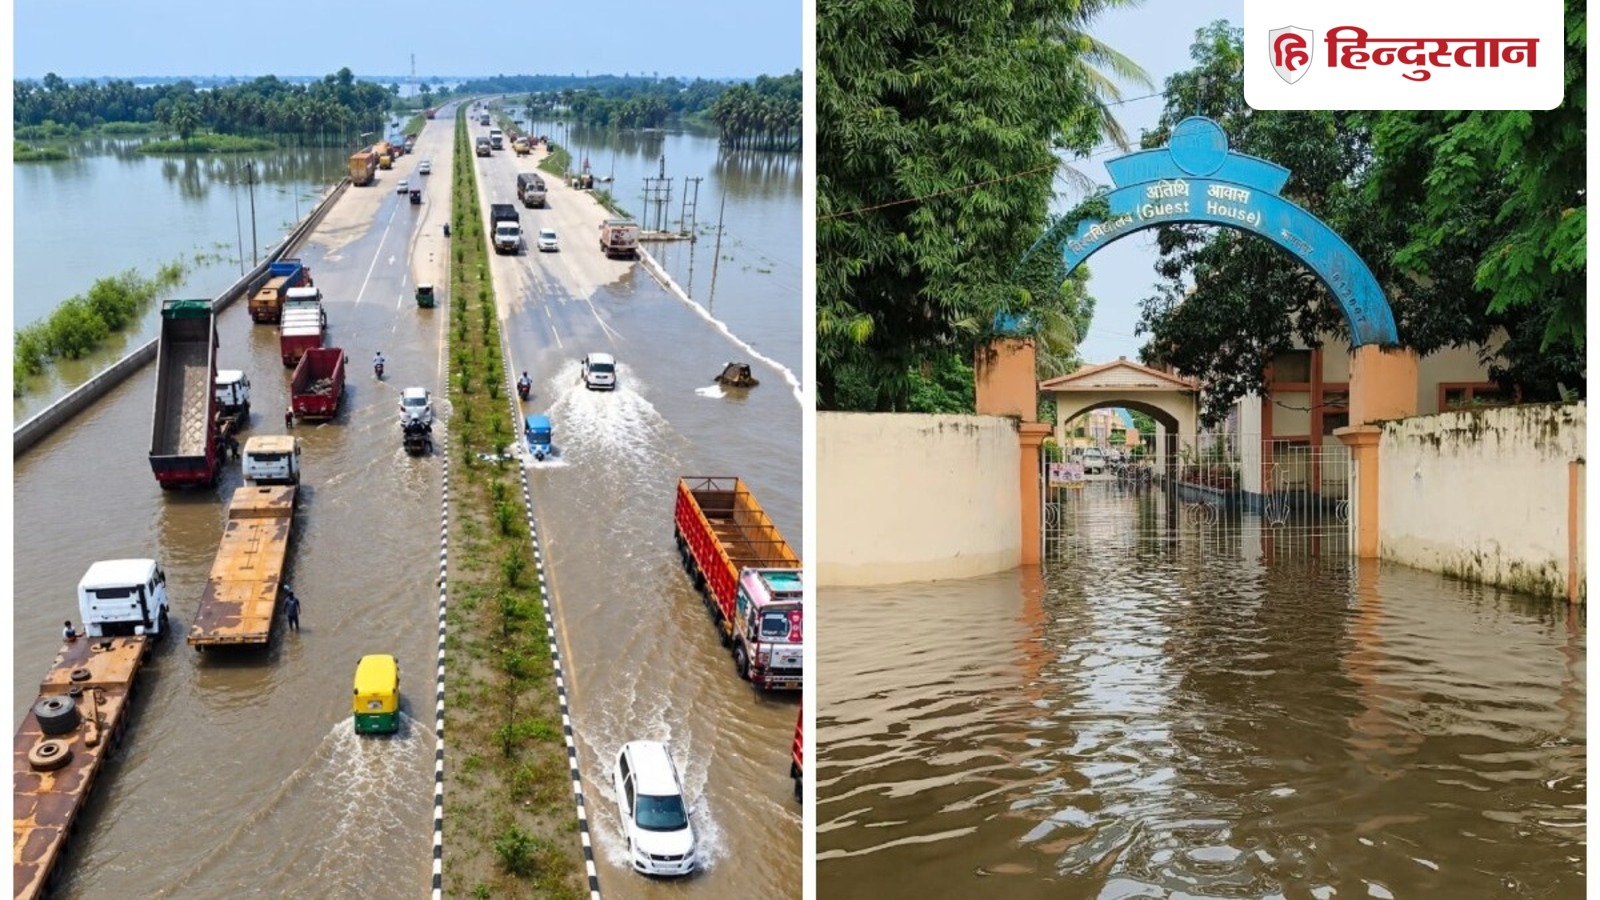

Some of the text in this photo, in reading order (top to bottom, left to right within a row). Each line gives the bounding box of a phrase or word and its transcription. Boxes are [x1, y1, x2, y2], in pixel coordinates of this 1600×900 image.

[1146, 179, 1250, 204] अतिथि आवास
[1137, 200, 1261, 227] (Guest House)
